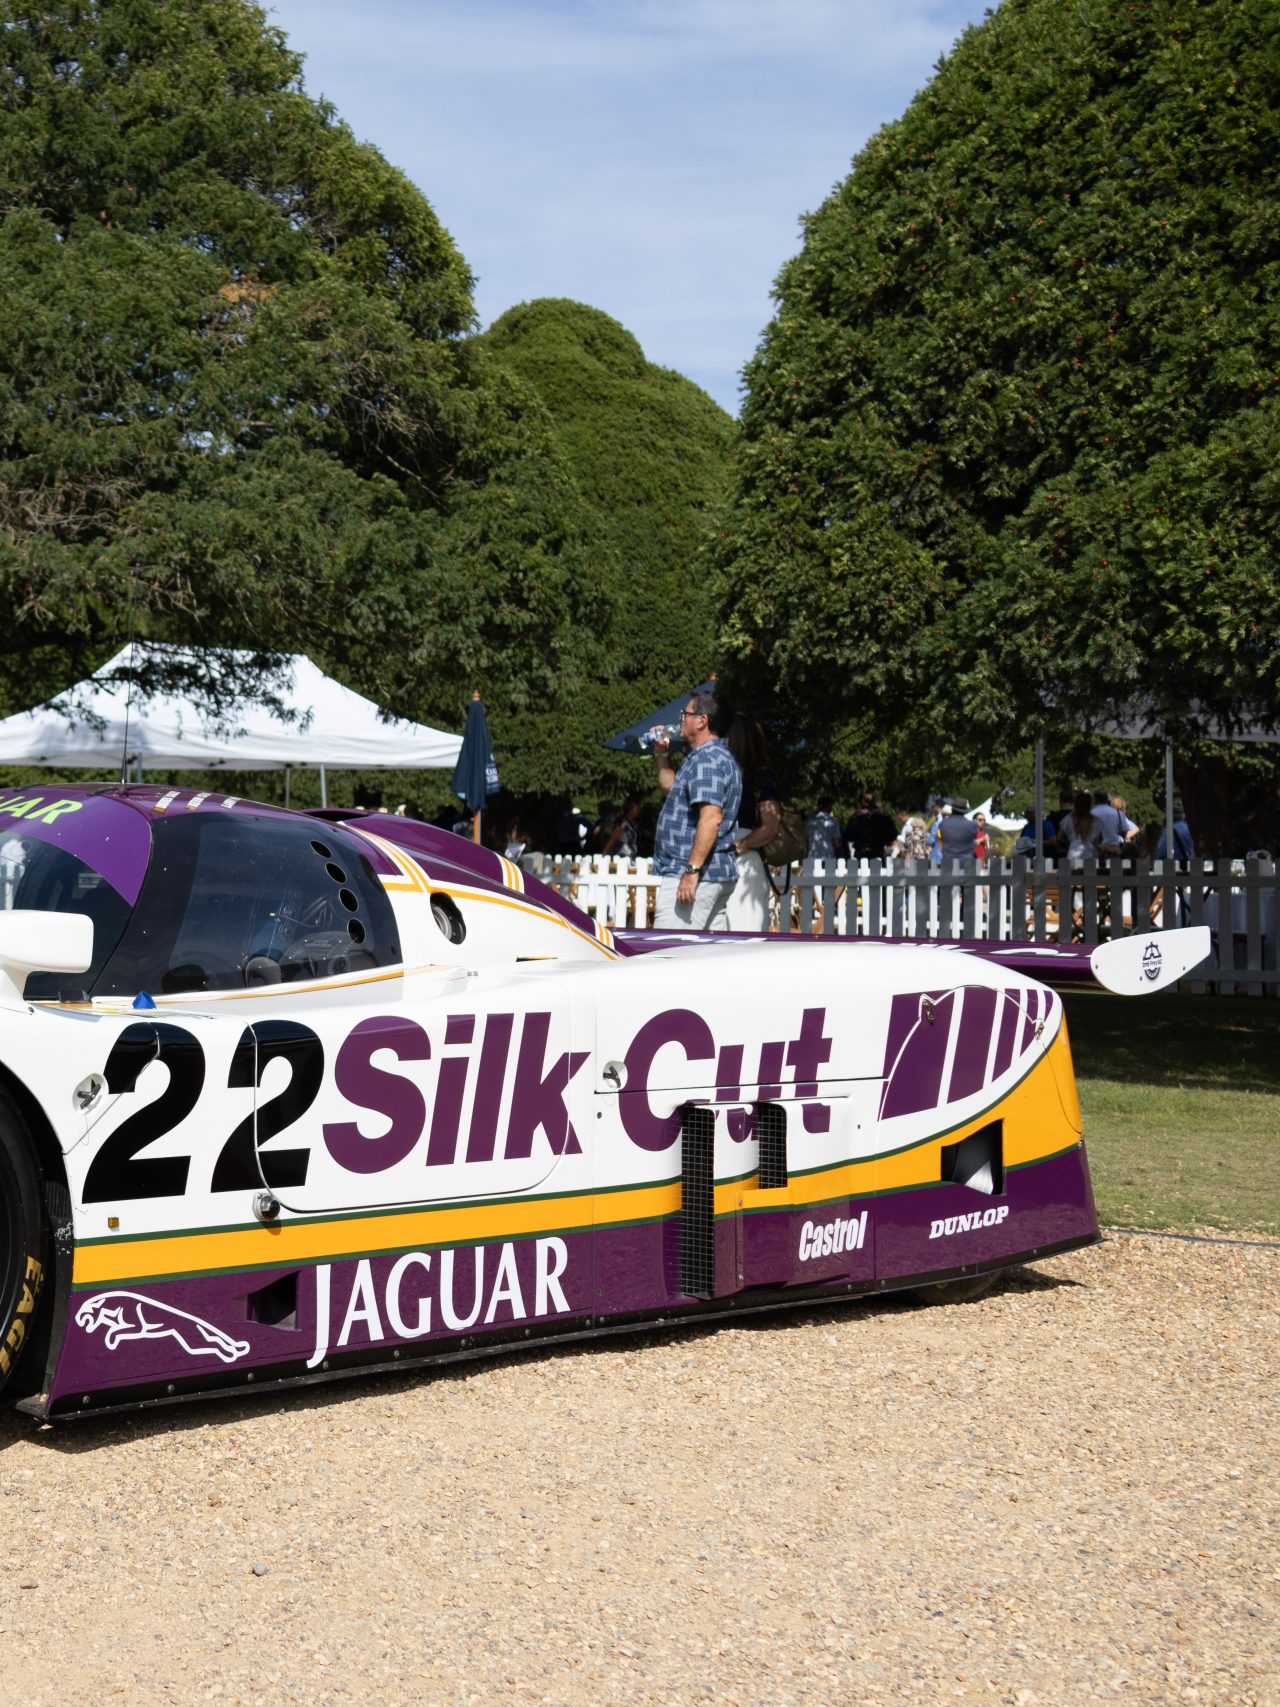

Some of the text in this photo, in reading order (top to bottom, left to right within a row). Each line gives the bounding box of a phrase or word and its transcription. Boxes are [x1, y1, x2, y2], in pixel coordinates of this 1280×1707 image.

[81, 1007, 834, 1205] 22 Silk Cut
[798, 1210, 869, 1262] Castrol
[928, 1205, 1010, 1240] DUNLOP
[306, 1236, 572, 1370] JAGUAR
